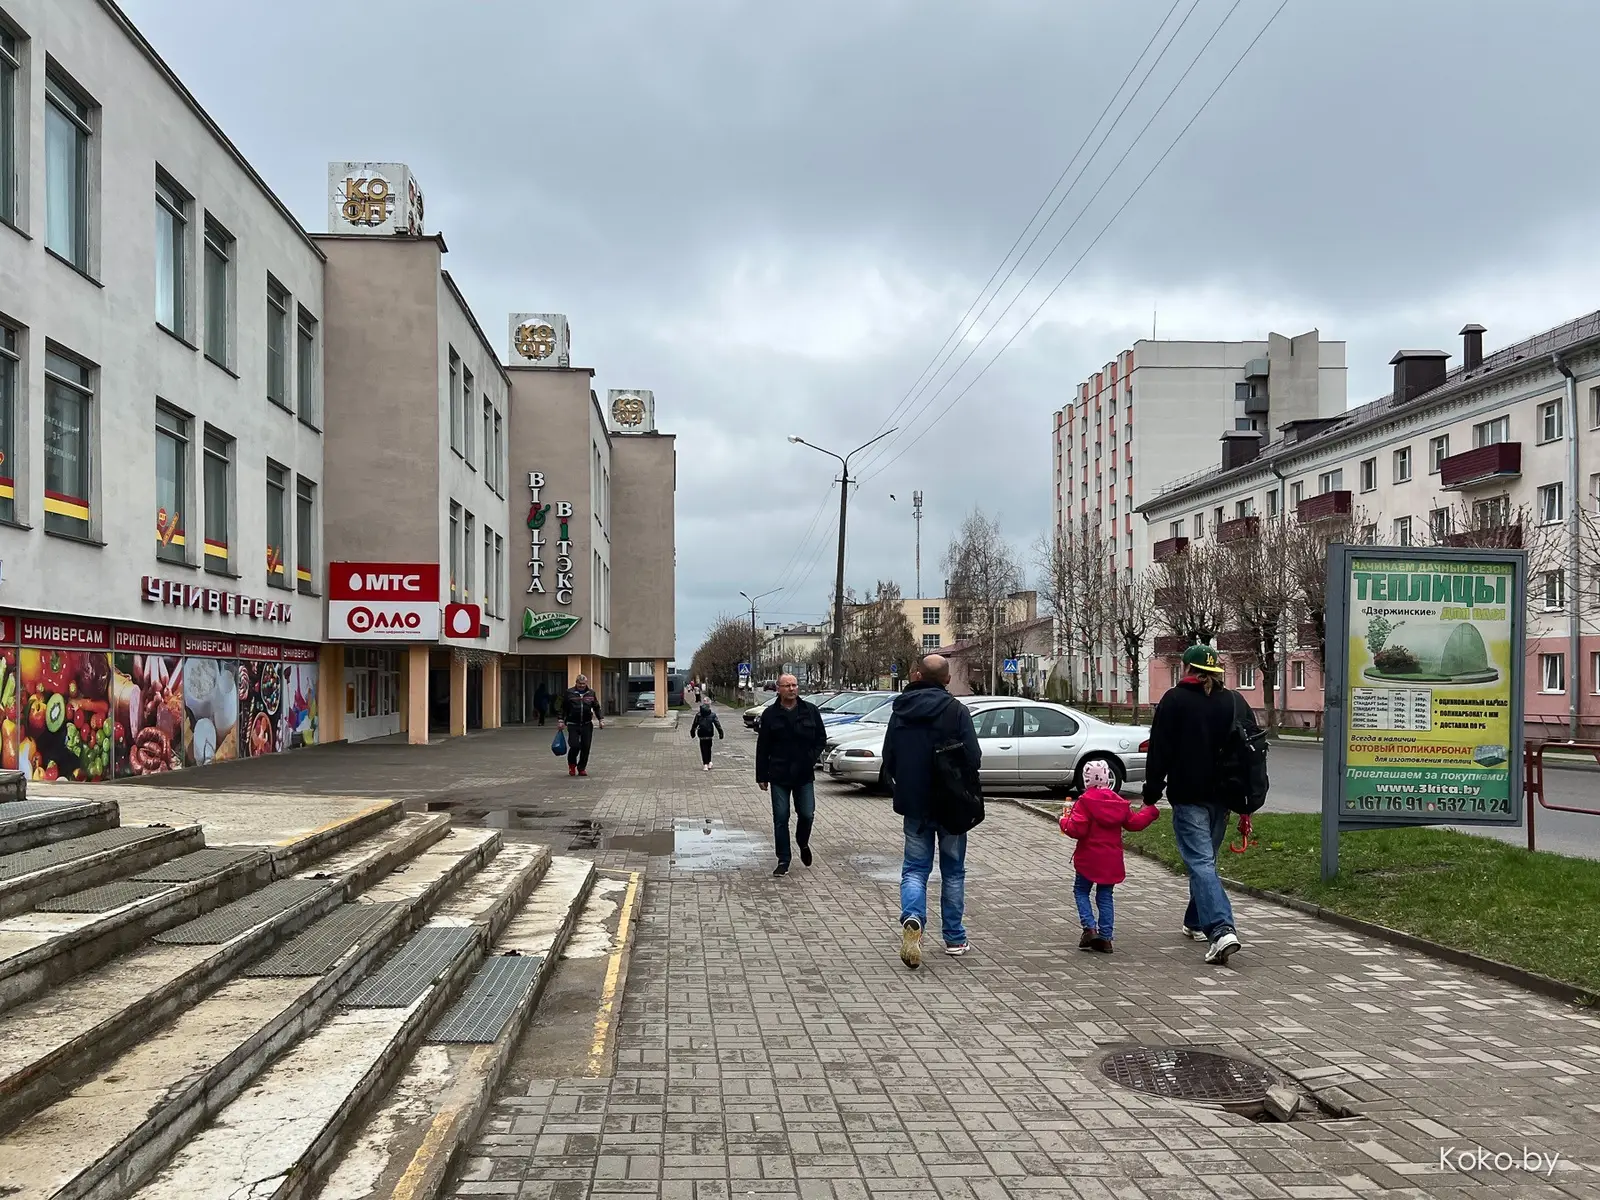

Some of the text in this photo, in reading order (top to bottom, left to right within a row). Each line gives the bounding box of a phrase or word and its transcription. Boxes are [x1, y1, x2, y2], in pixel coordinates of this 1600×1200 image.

[1352, 562, 1415, 571] НАЧИНАЕМ
[365, 574, 420, 591] МТС
[1353, 572, 1506, 607] ТЕПЛИЦЫ
[142, 575, 293, 622] УНИВЕРСАМ
[1361, 606, 1436, 616] «Дзержинские»
[24, 623, 103, 644] УНИВЕРСАМ
[116, 632, 176, 649] ПРИГЛАШАЕМ
[186, 639, 233, 653] УНИВЕРСАМ
[240, 644, 278, 657] ПРИГЛАШАЕМ
[1349, 744, 1473, 755] СОТОВЫЙ ПОЛИКАРБОНАТ
[1346, 768, 1508, 781] Приглашаем за покупками!
[1376, 783, 1481, 796] www.3kita.by
[1357, 796, 1508, 813] 167 76 91 532 74 24
